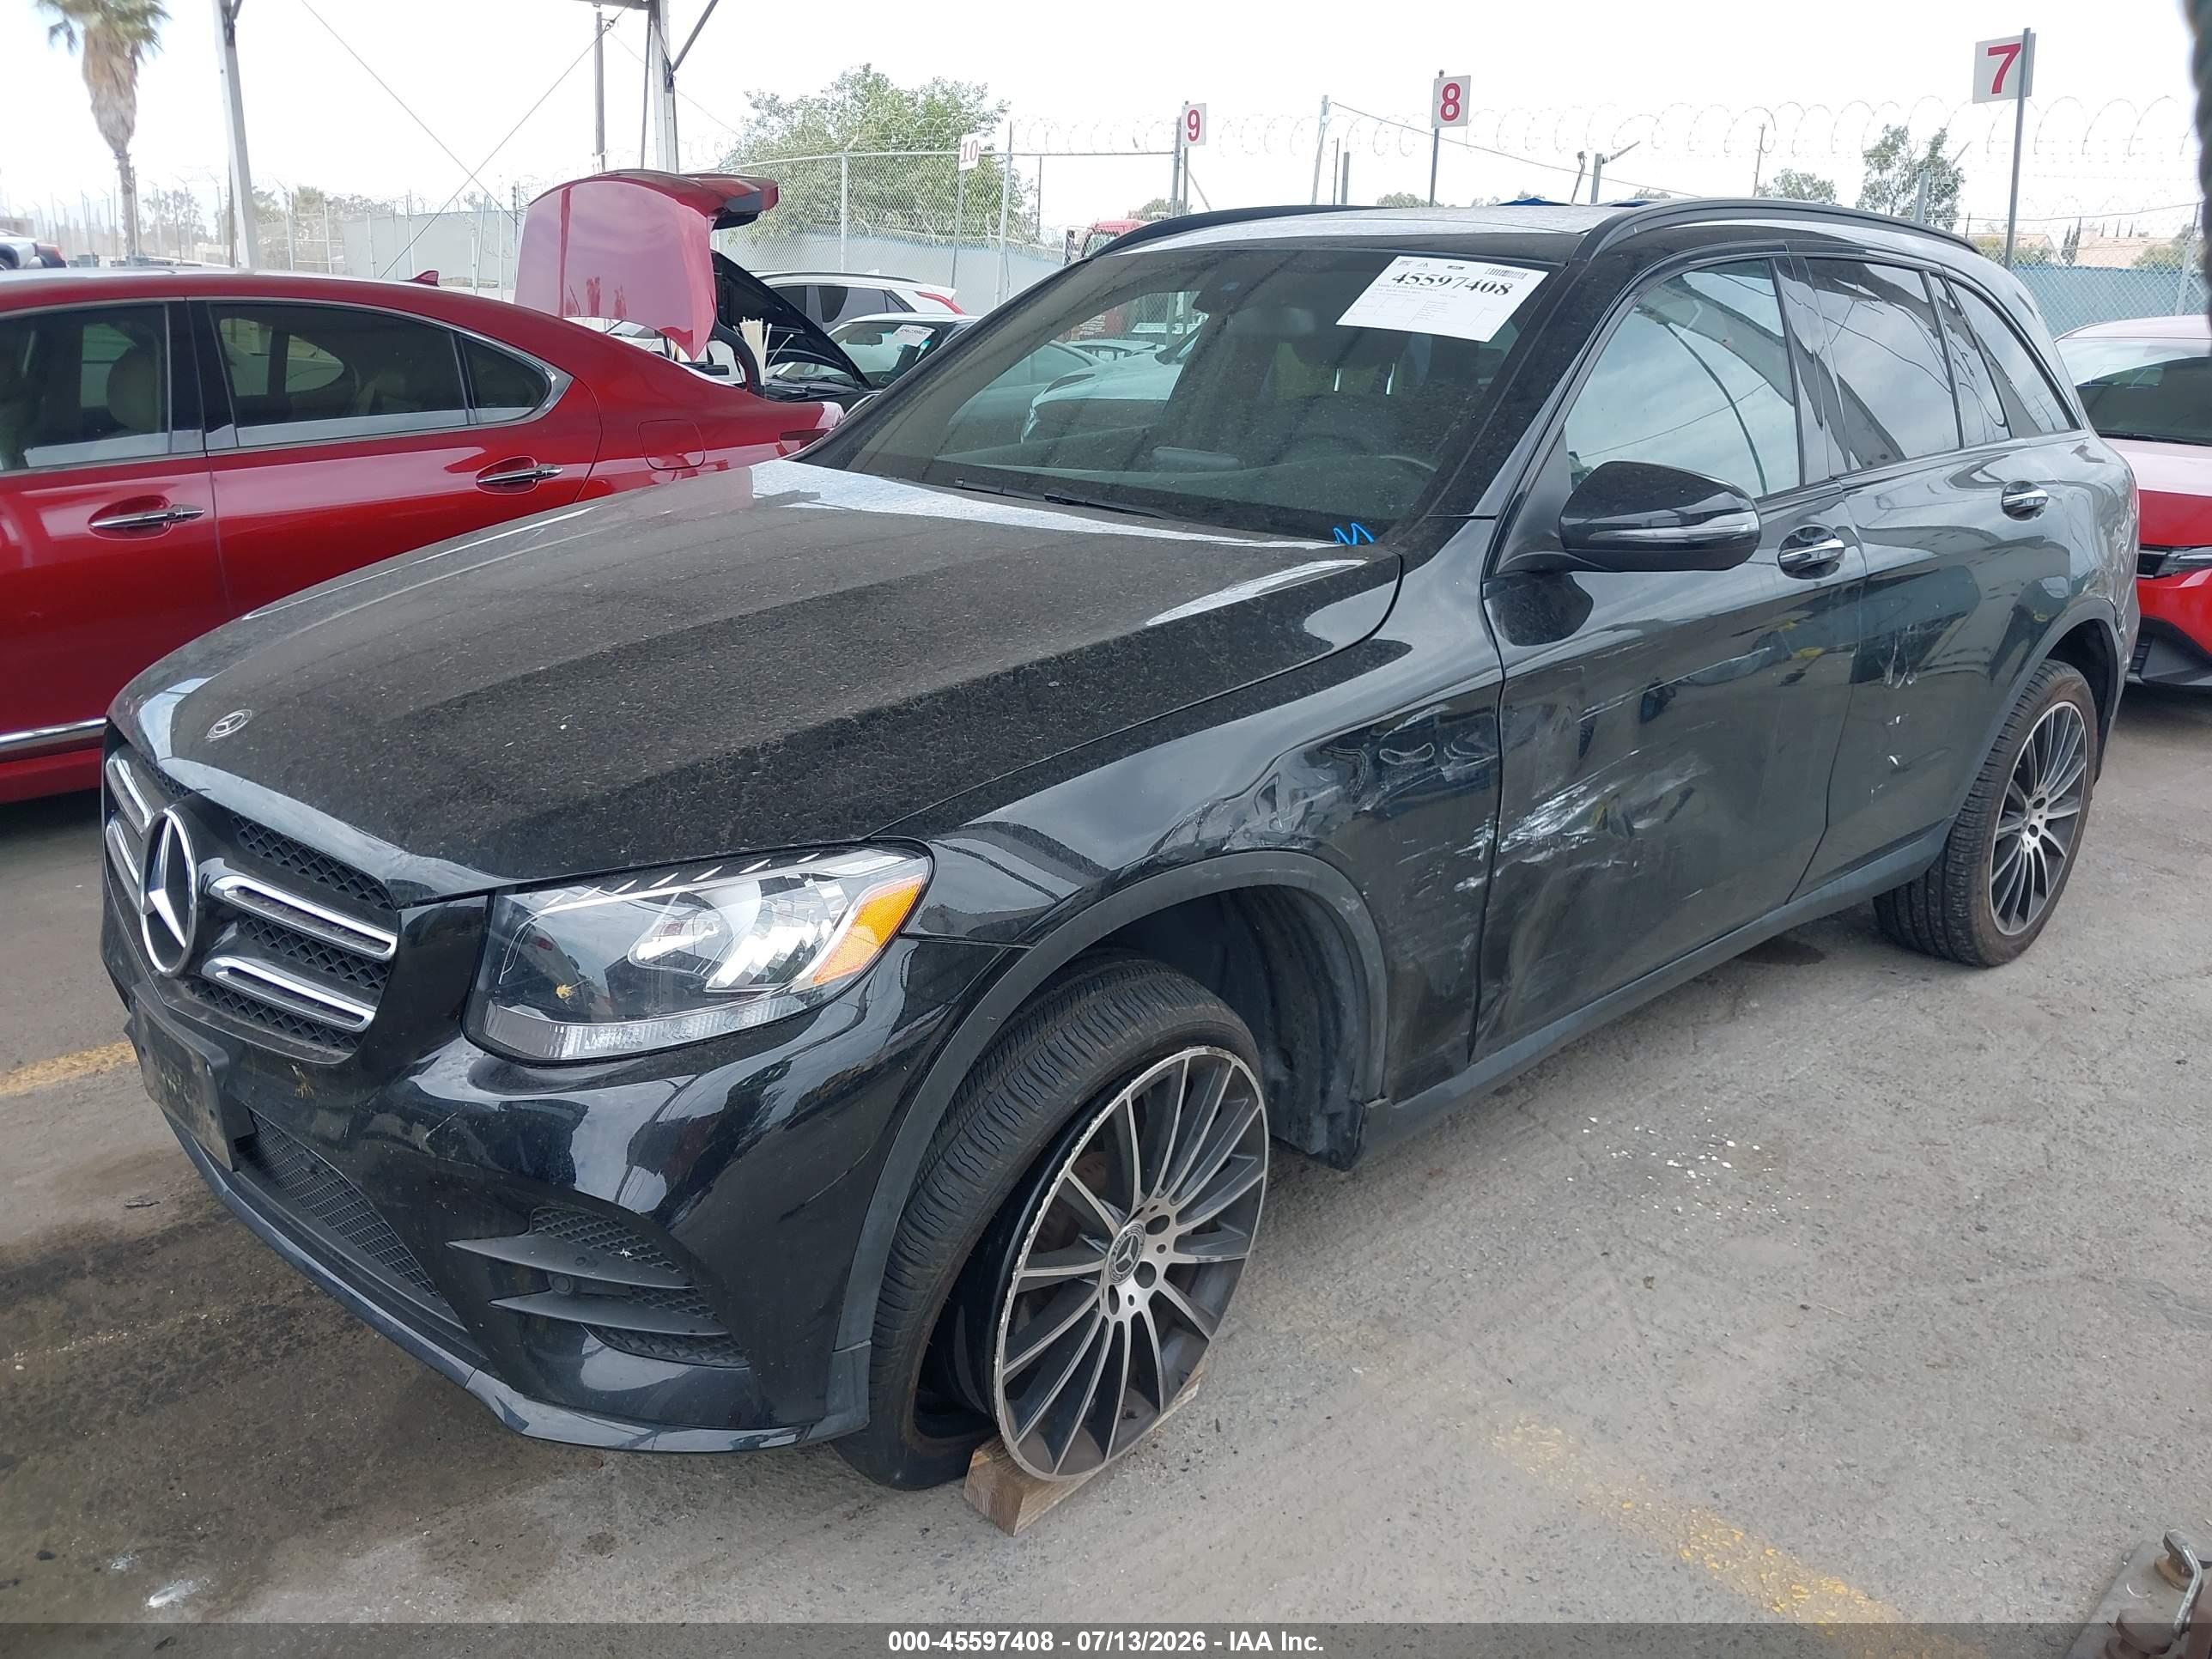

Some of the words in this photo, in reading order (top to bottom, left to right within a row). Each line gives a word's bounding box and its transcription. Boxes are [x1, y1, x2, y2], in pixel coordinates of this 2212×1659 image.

[1987, 43, 2021, 94] 7
[1440, 82, 1461, 121] 8
[1187, 109, 1200, 142] 9
[961, 139, 979, 163] 10
[1391, 271, 1514, 296] 45597408
